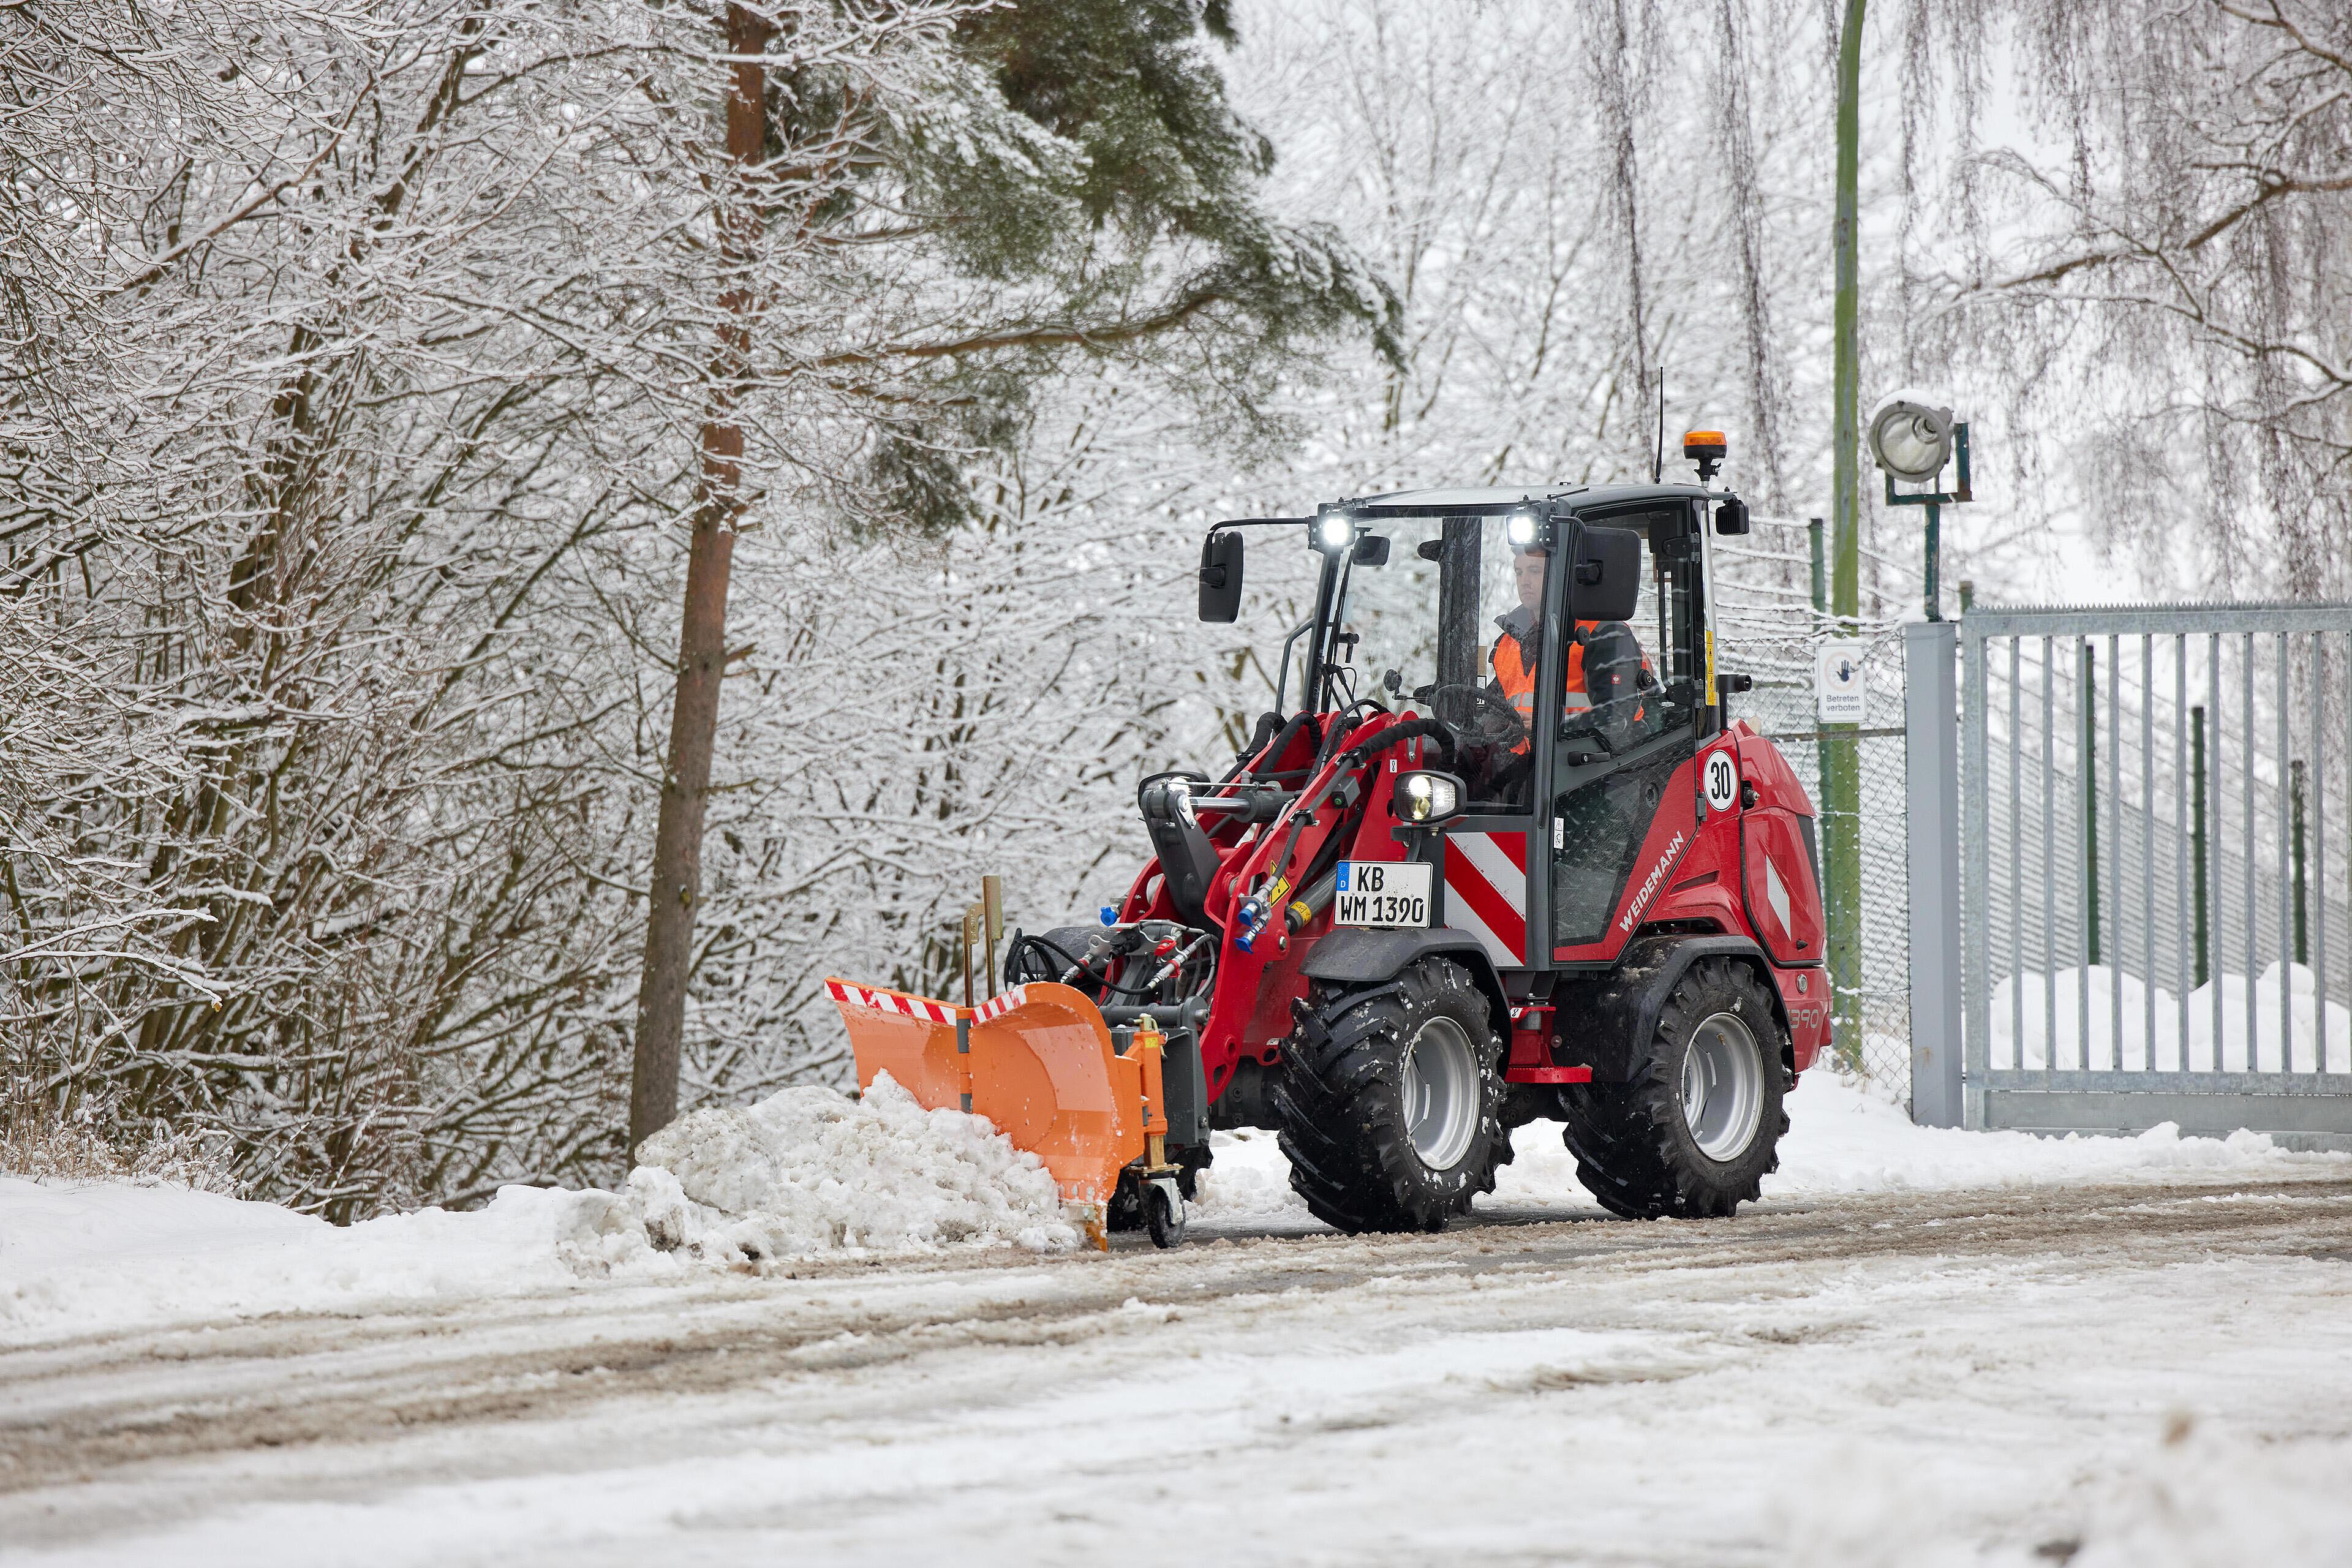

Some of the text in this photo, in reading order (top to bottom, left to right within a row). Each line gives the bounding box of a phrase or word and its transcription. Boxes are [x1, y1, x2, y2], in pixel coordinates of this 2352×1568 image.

[1711, 761, 1730, 799] 30
[1357, 867, 1384, 891] KB
[1619, 831, 1684, 932] WEIDEMANN
[1341, 896, 1424, 923] WM 1390
